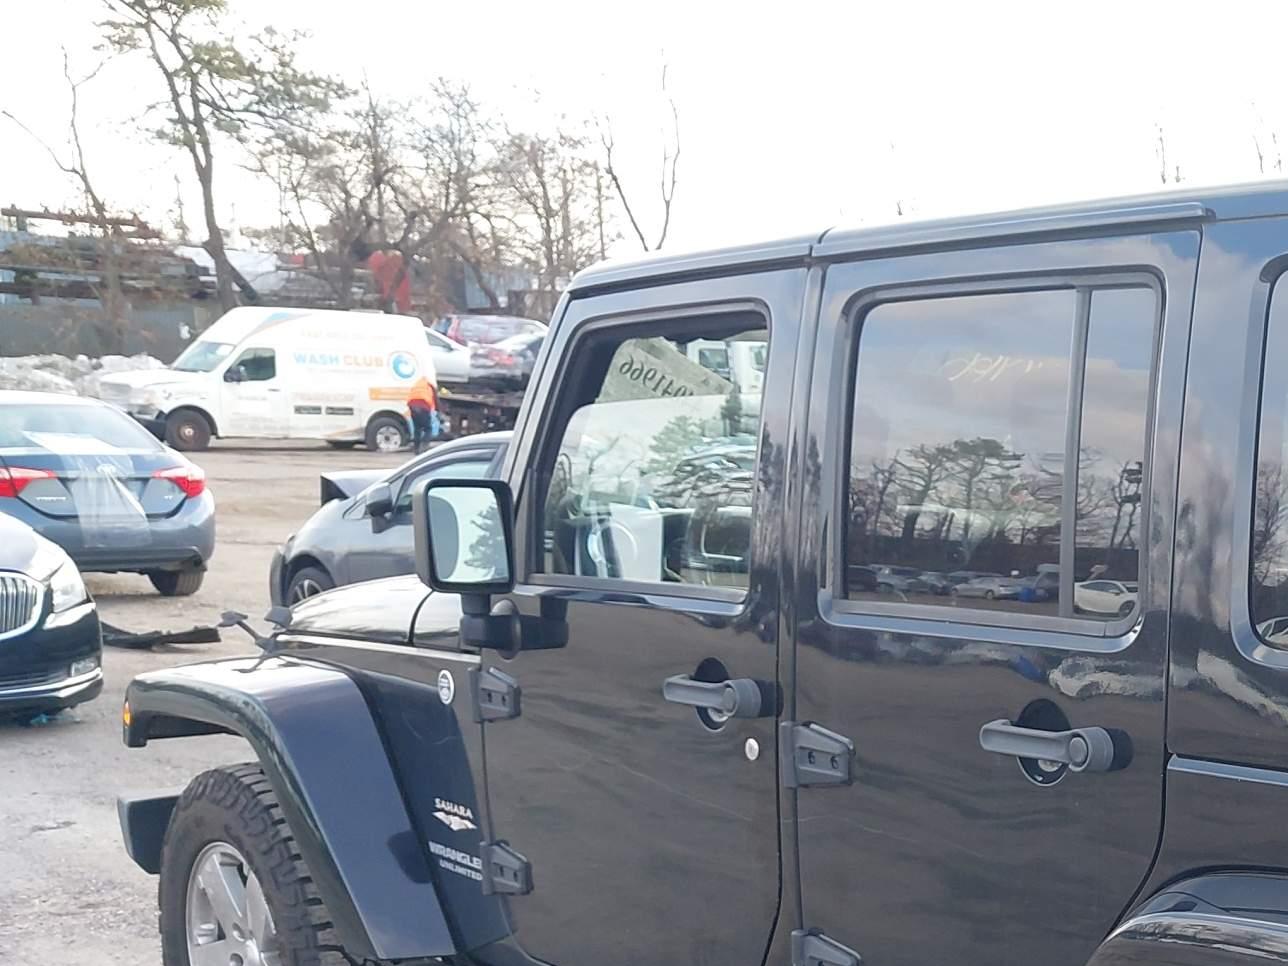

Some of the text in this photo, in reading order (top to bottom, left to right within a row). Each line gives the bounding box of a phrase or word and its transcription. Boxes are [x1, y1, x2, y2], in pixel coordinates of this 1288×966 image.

[293, 352, 385, 368] WASH CLUB
[433, 797, 473, 820] SAHARA
